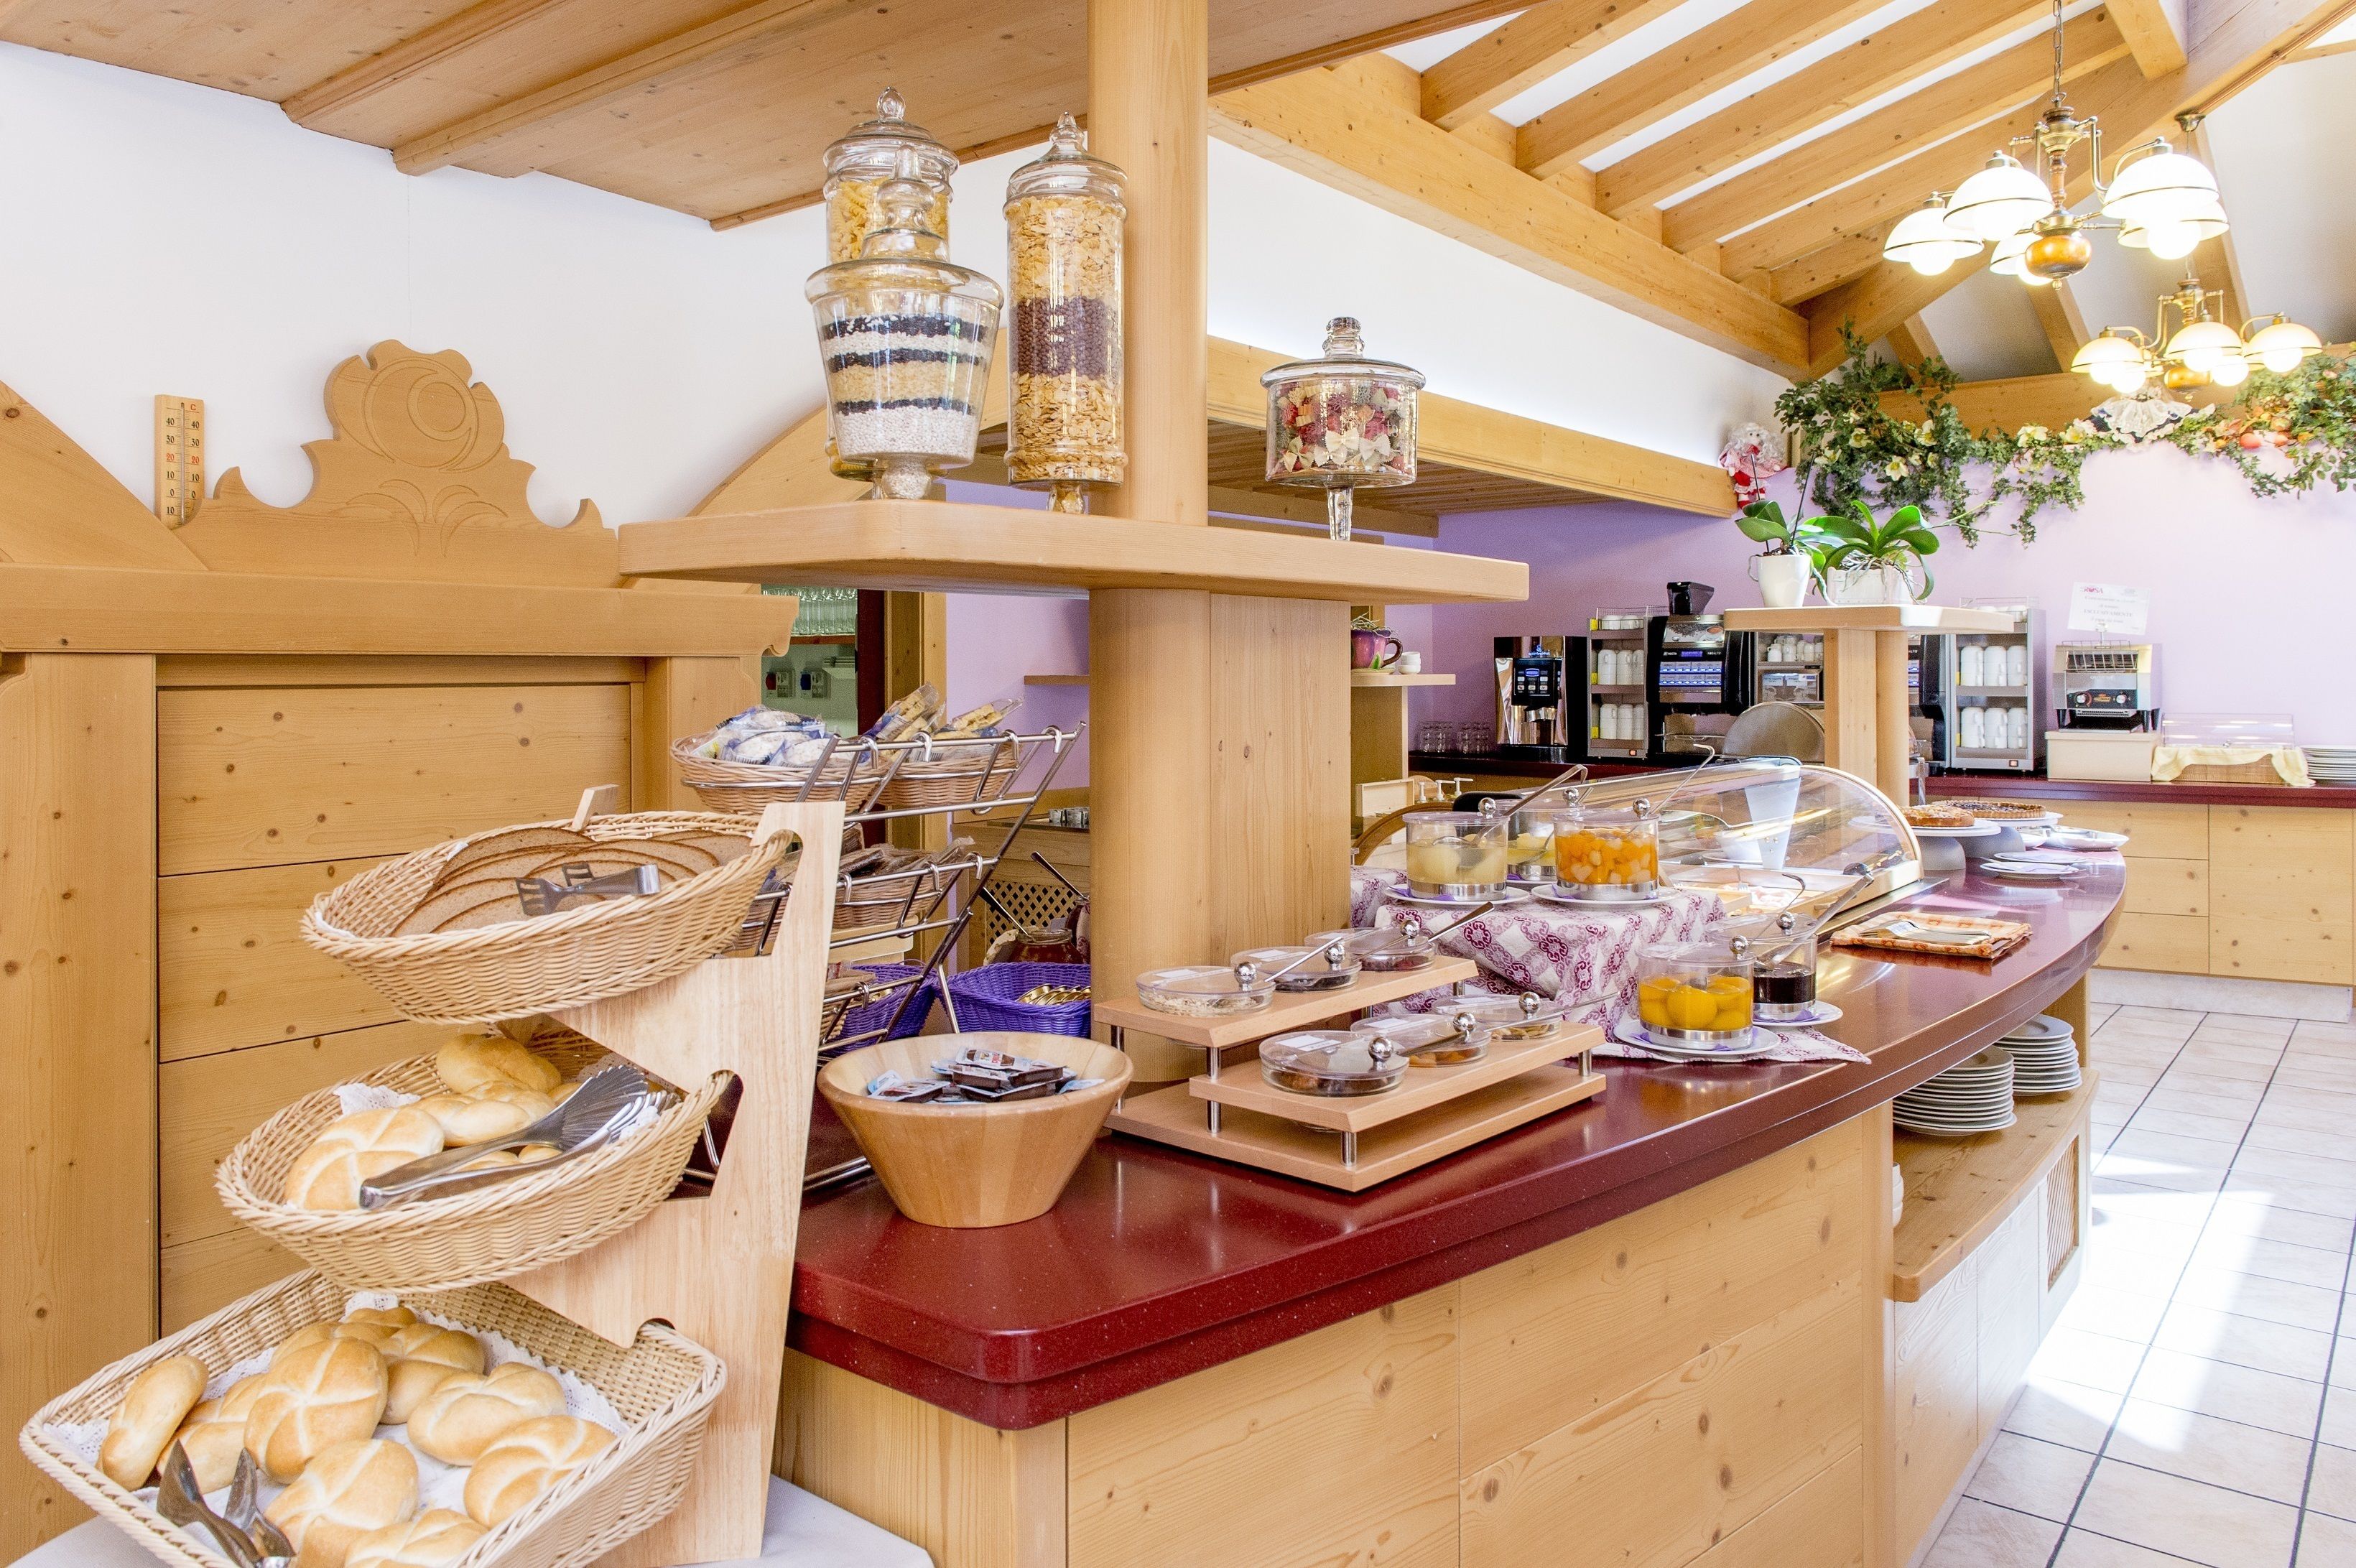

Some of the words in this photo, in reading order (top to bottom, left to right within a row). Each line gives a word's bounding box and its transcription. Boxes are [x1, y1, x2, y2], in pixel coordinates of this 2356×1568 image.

[166, 417, 175, 426] 40
[166, 435, 175, 443] 30
[191, 438, 200, 447] 30
[191, 455, 200, 464] 20
[192, 473, 200, 482] 10
[191, 491, 196, 499] 0
